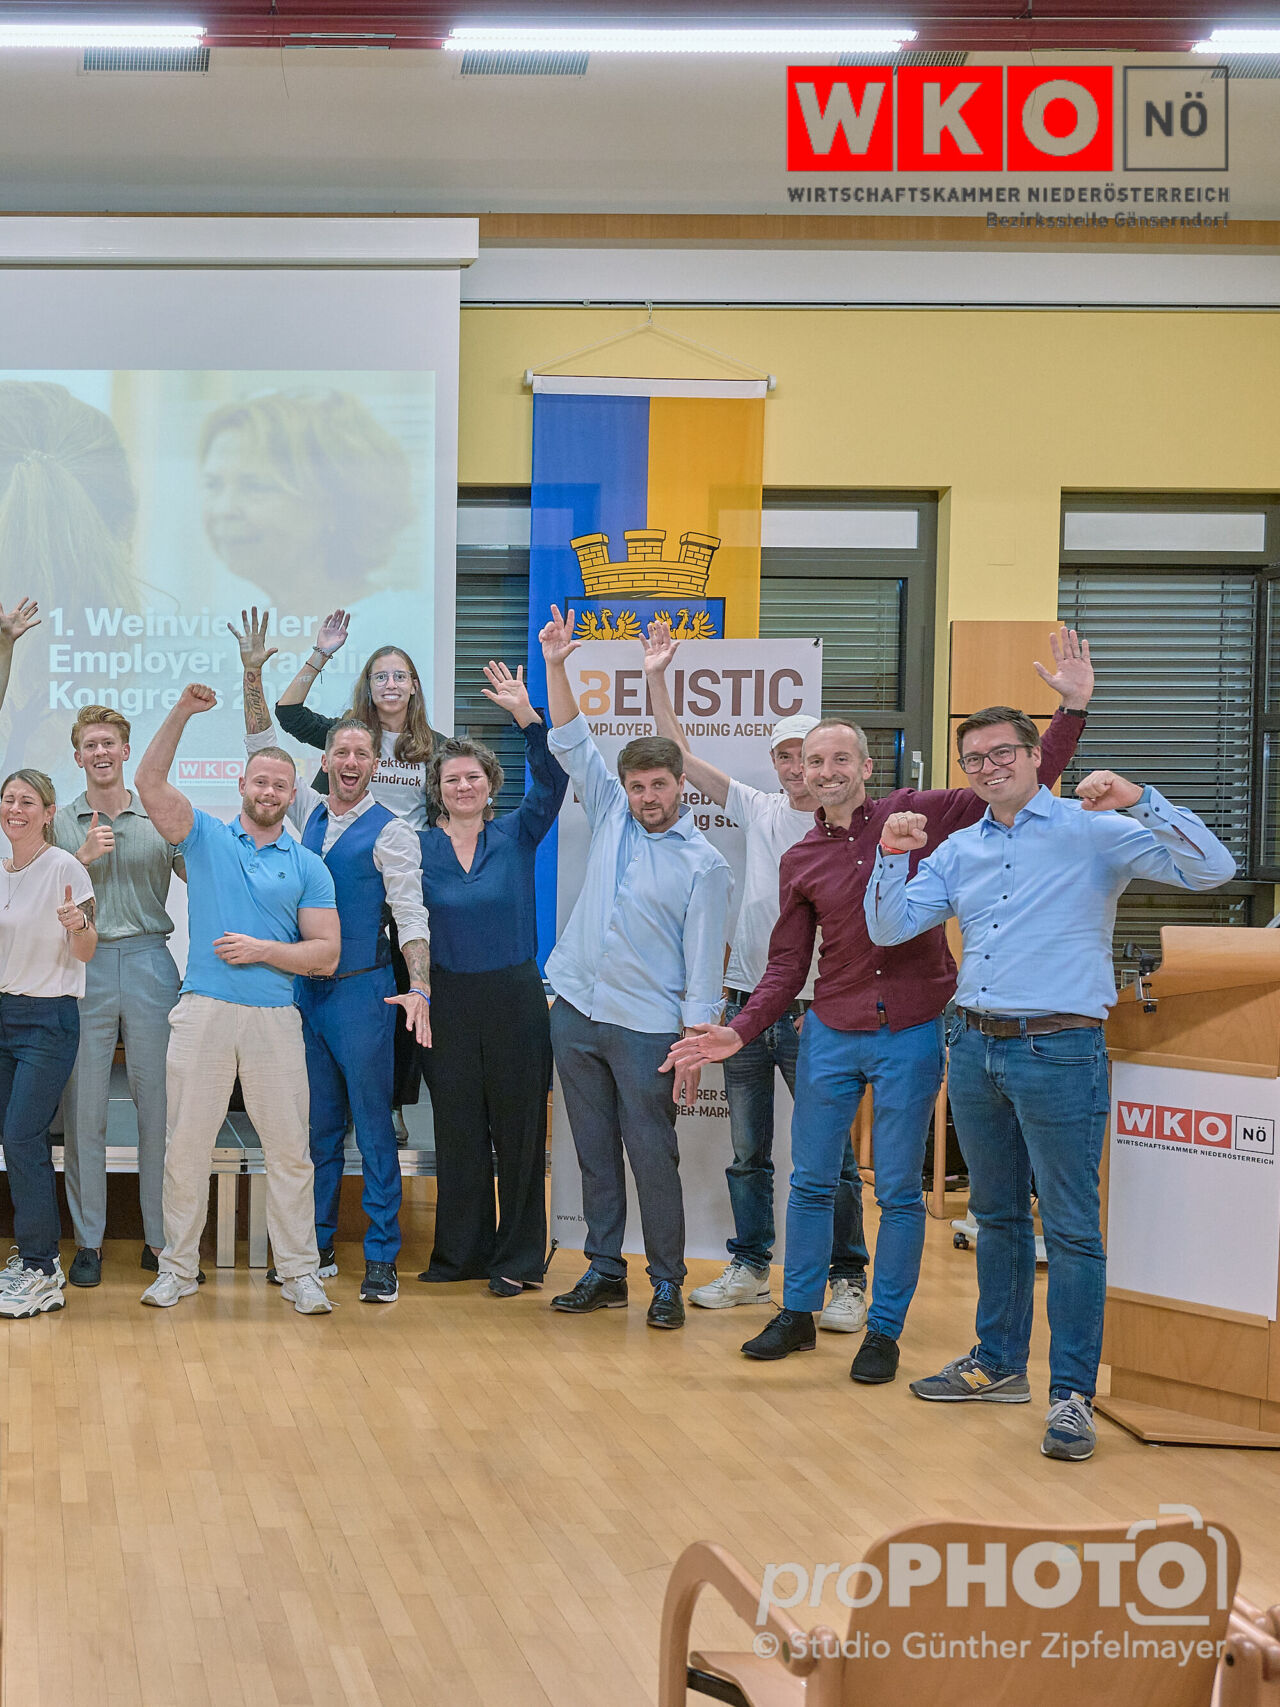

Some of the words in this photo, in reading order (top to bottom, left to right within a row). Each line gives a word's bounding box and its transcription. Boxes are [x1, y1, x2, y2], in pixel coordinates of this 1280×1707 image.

[49, 607, 74, 637] 1.
[49, 644, 226, 679] Employer
[48, 681, 223, 716] Kongres
[733, 723, 777, 736] AGEN
[180, 762, 241, 777] WKO
[1119, 1105, 1227, 1143] WKO
[1242, 1126, 1267, 1143] NÖ
[1116, 1138, 1198, 1155] WIRTSCHAFTSKAMMER
[1200, 1150, 1275, 1166] NIEDERÖSTERREICH
